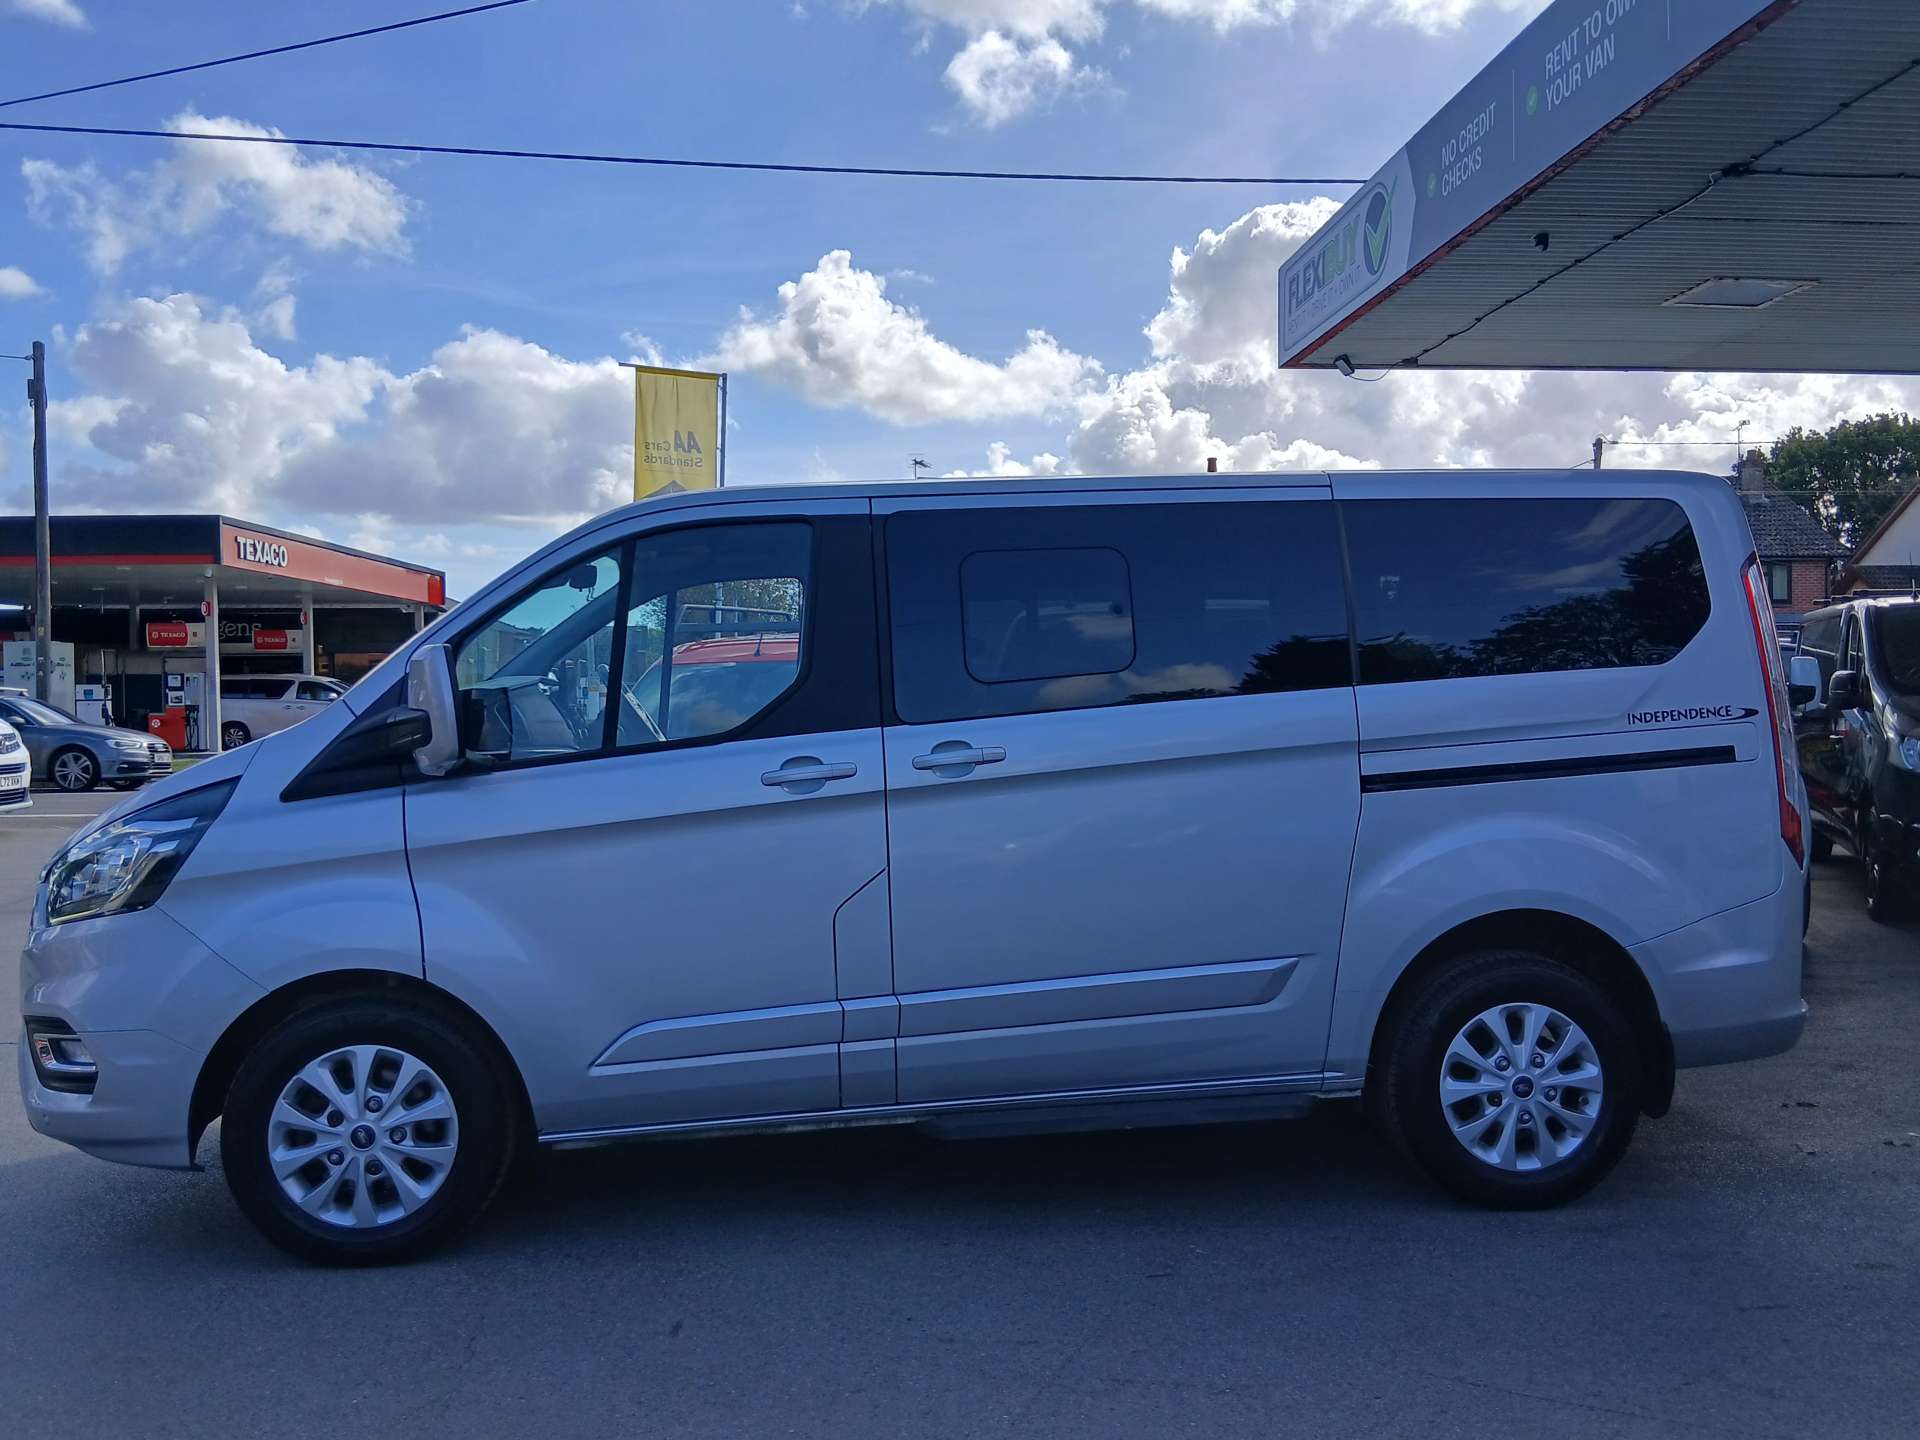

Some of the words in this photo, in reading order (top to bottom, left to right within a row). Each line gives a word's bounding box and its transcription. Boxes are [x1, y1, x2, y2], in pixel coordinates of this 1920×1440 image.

[1545, 27, 1579, 80] RENT
[1583, 10, 1602, 45] TO
[1606, 0, 1637, 26] OW
[1546, 62, 1582, 112] YOUR
[1585, 33, 1615, 79] VAN
[1442, 139, 1457, 169] NO
[1459, 101, 1496, 153] CREDIT
[1442, 145, 1482, 197] CHECKS
[236, 535, 288, 568] TEXACO
[1627, 704, 1733, 725] INDEPENDENCE
